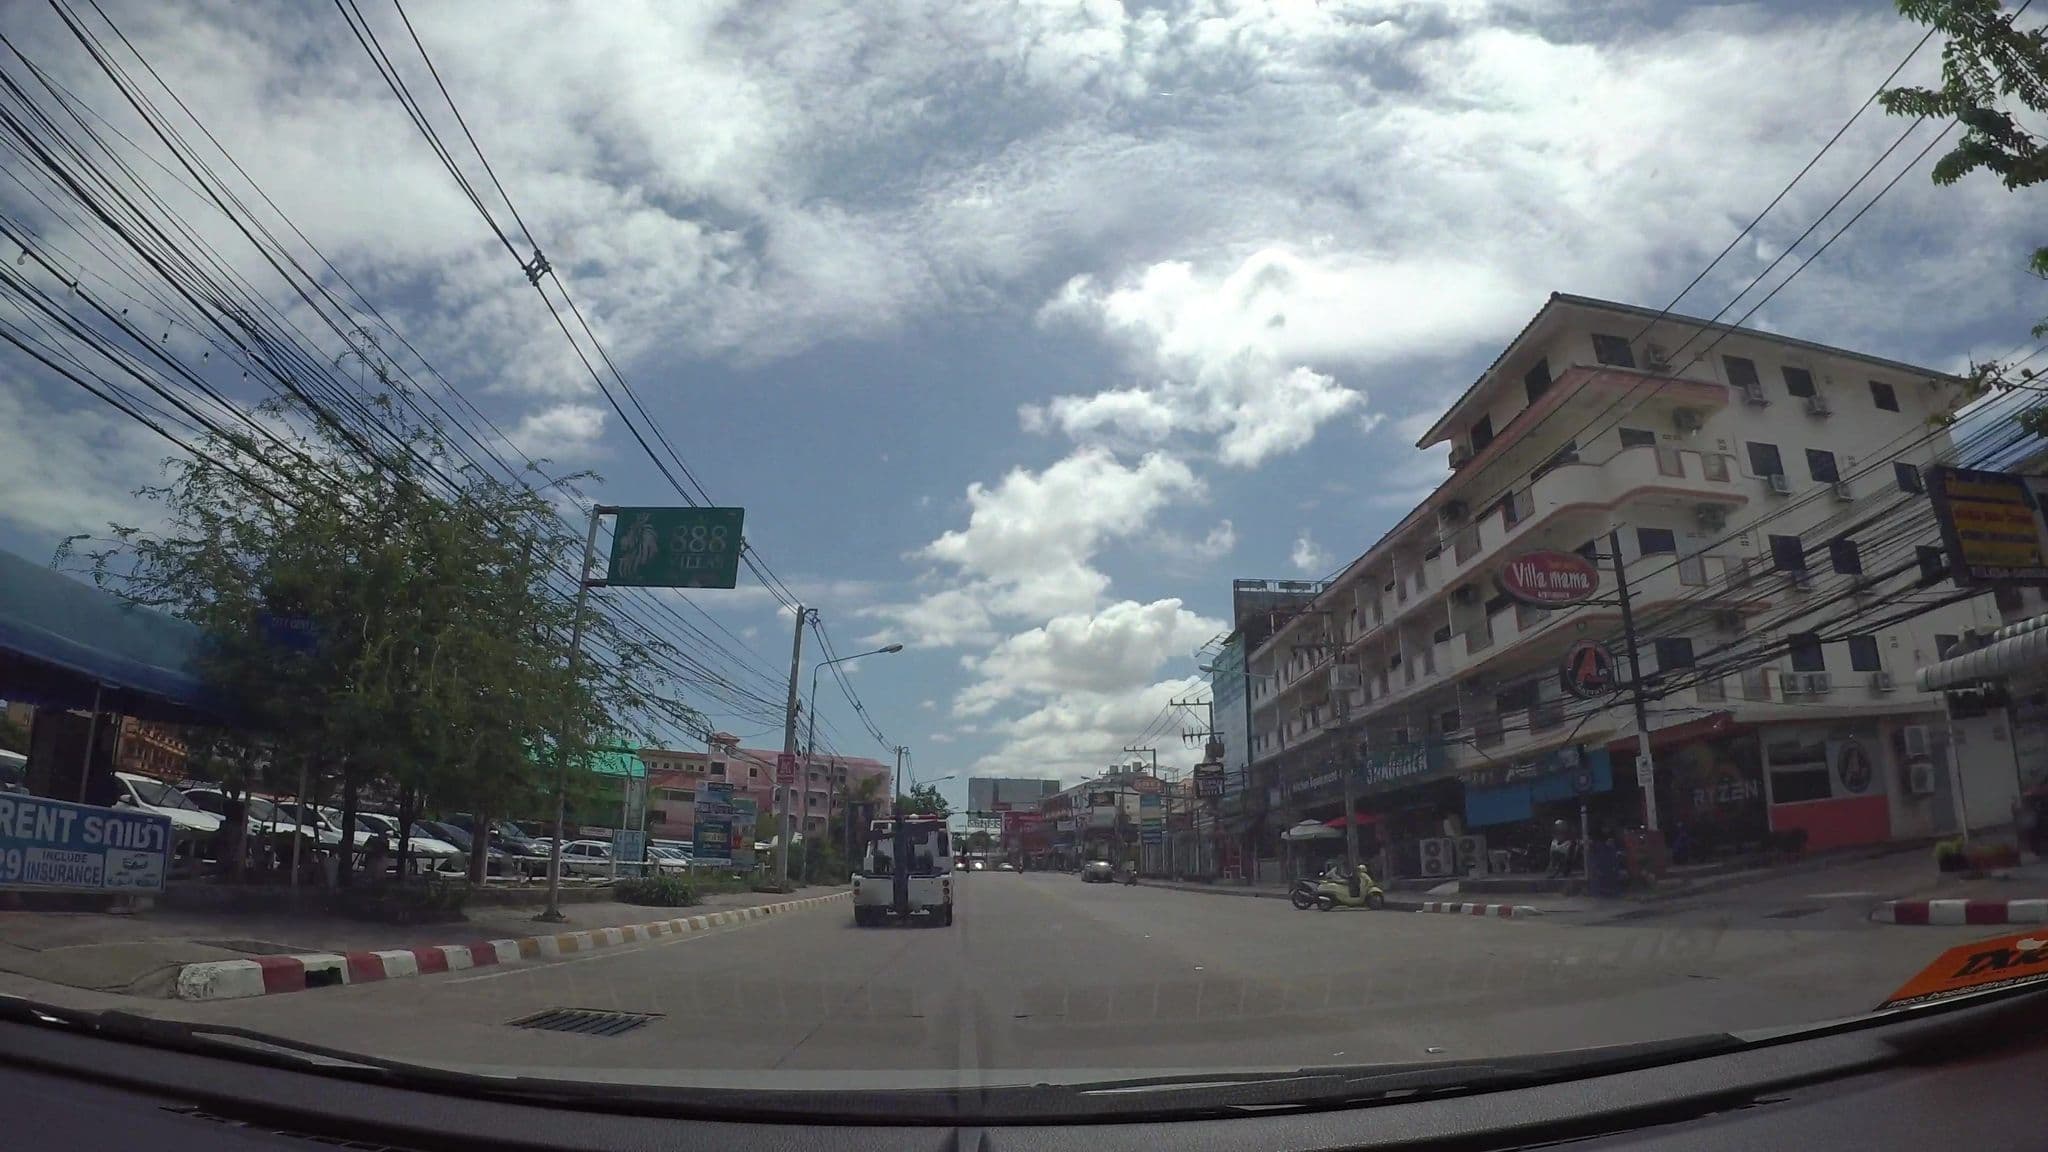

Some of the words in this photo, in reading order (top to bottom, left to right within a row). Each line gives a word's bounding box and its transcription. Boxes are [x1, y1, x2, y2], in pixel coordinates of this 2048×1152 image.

[672, 524, 728, 554] 888
[1512, 562, 1547, 588] Villa
[1550, 570, 1590, 589] mama
[0, 799, 77, 844] RENT
[83, 815, 165, 850] รถเช่า
[42, 851, 89, 863] INCLUDE
[26, 861, 101, 884] INSURANCE
